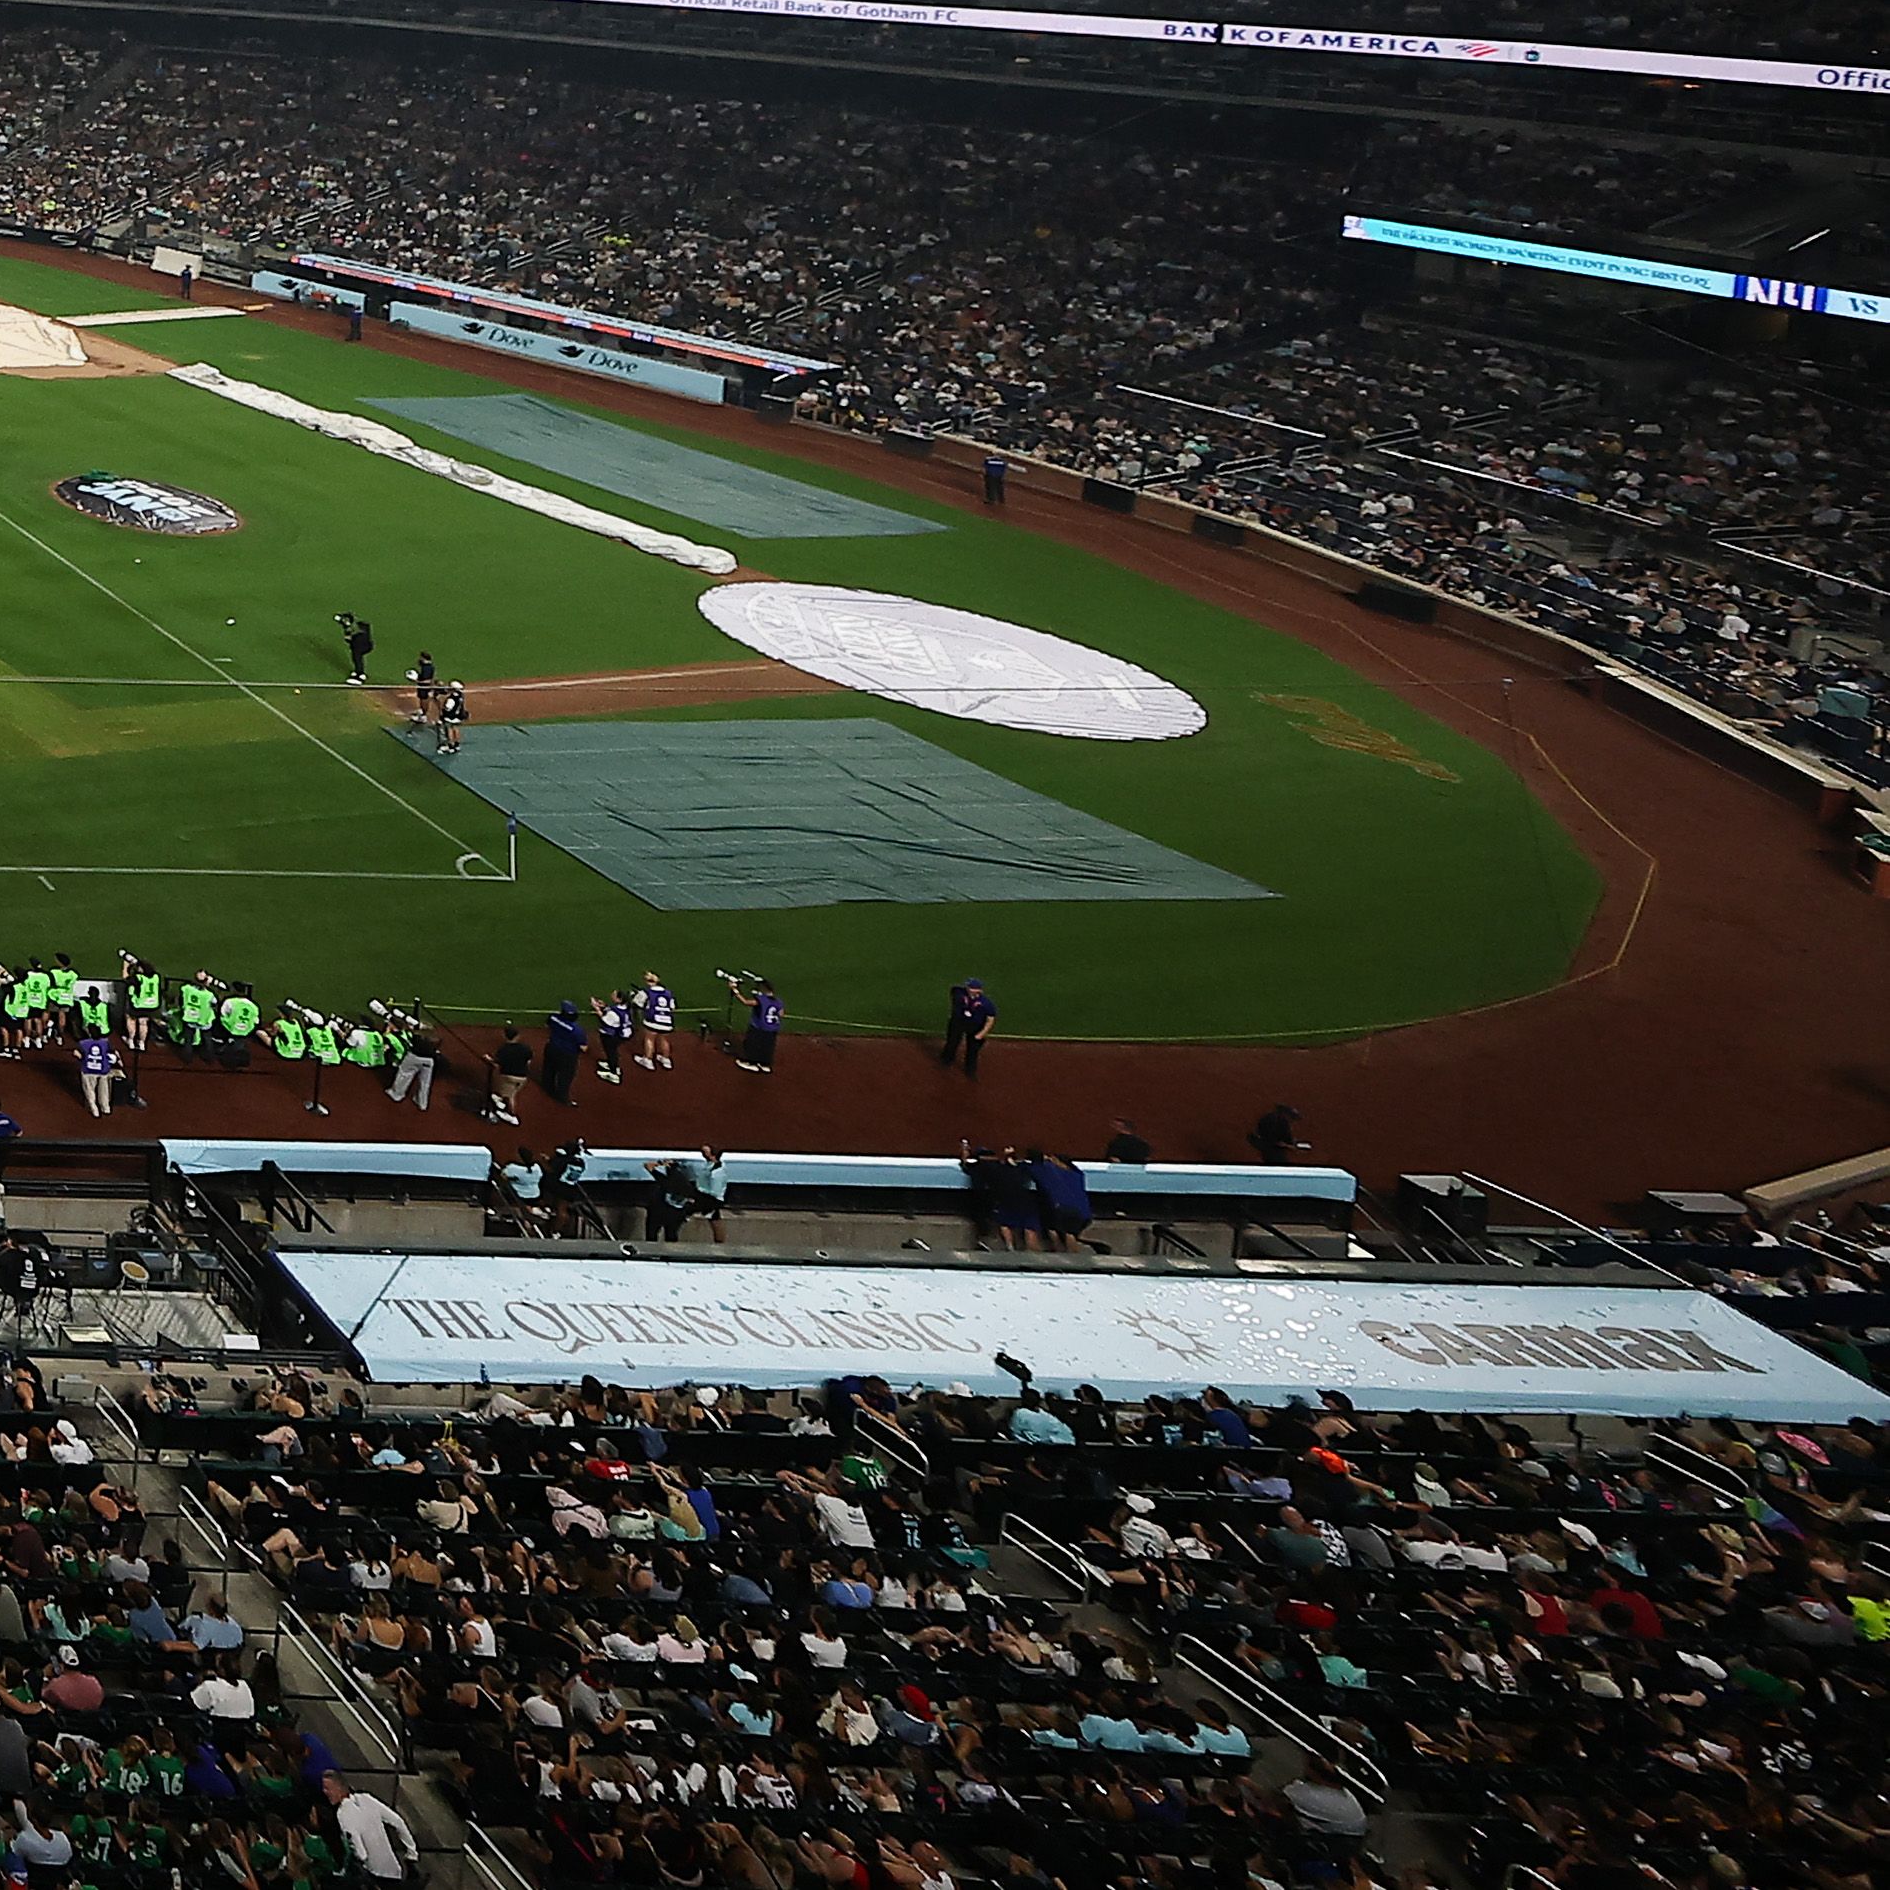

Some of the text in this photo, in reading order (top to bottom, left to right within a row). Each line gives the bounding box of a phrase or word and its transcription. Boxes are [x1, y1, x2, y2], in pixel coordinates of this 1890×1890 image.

[785, 0, 826, 14] Bank
[831, 2, 850, 16] of
[856, 4, 928, 22] Gotham
[934, 9, 959, 23] FC
[1163, 24, 1441, 54] BANK OF AMERICA
[488, 325, 535, 350] Dove
[588, 349, 638, 375] Dove
[388, 1297, 983, 1354] THE QUEENS CLASSIC
[160, 1770, 184, 1796] 16
